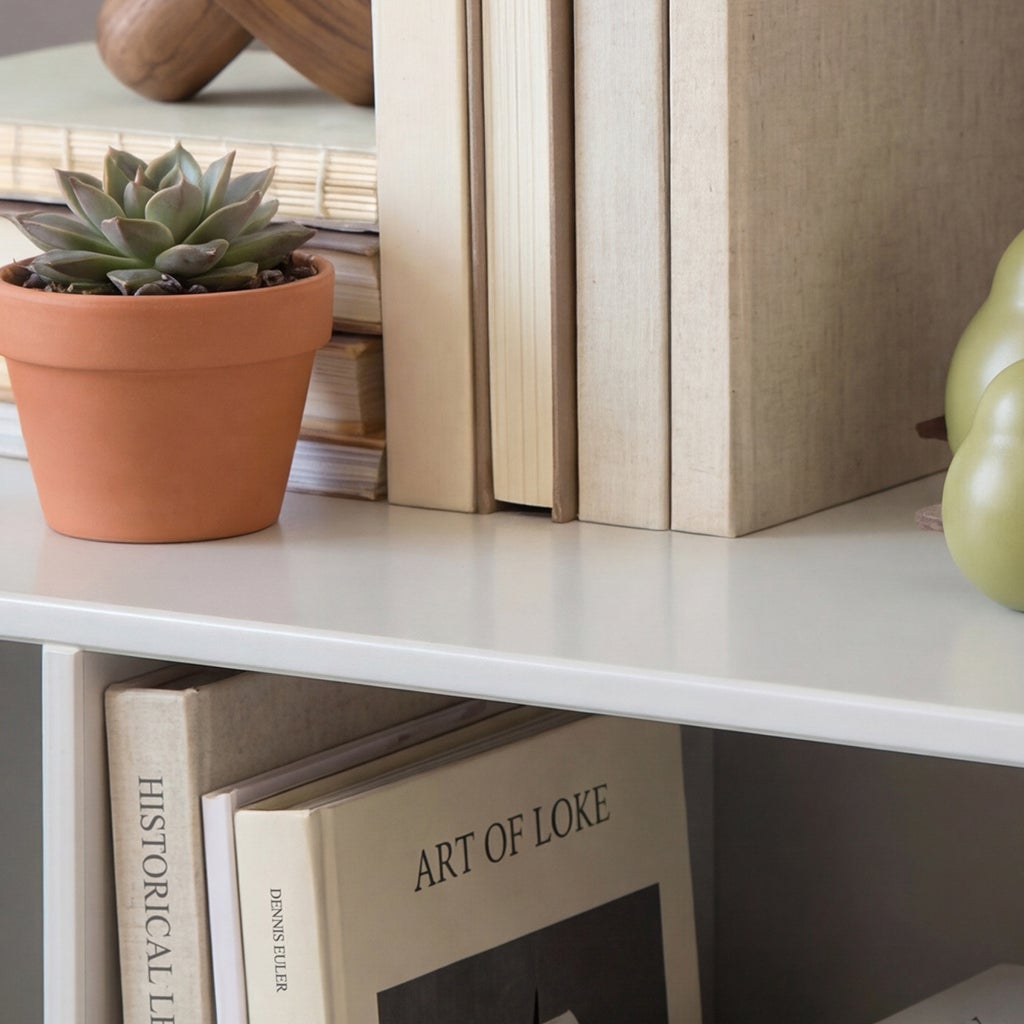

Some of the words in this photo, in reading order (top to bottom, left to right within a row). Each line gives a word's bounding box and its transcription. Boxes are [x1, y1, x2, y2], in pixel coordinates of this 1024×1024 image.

[413, 830, 476, 893] ART
[484, 813, 525, 864] OF
[532, 783, 612, 848] LOKE
[138, 775, 173, 985] HISTORICAL
[269, 888, 286, 943] DENNIS
[273, 945, 289, 994] EULER
